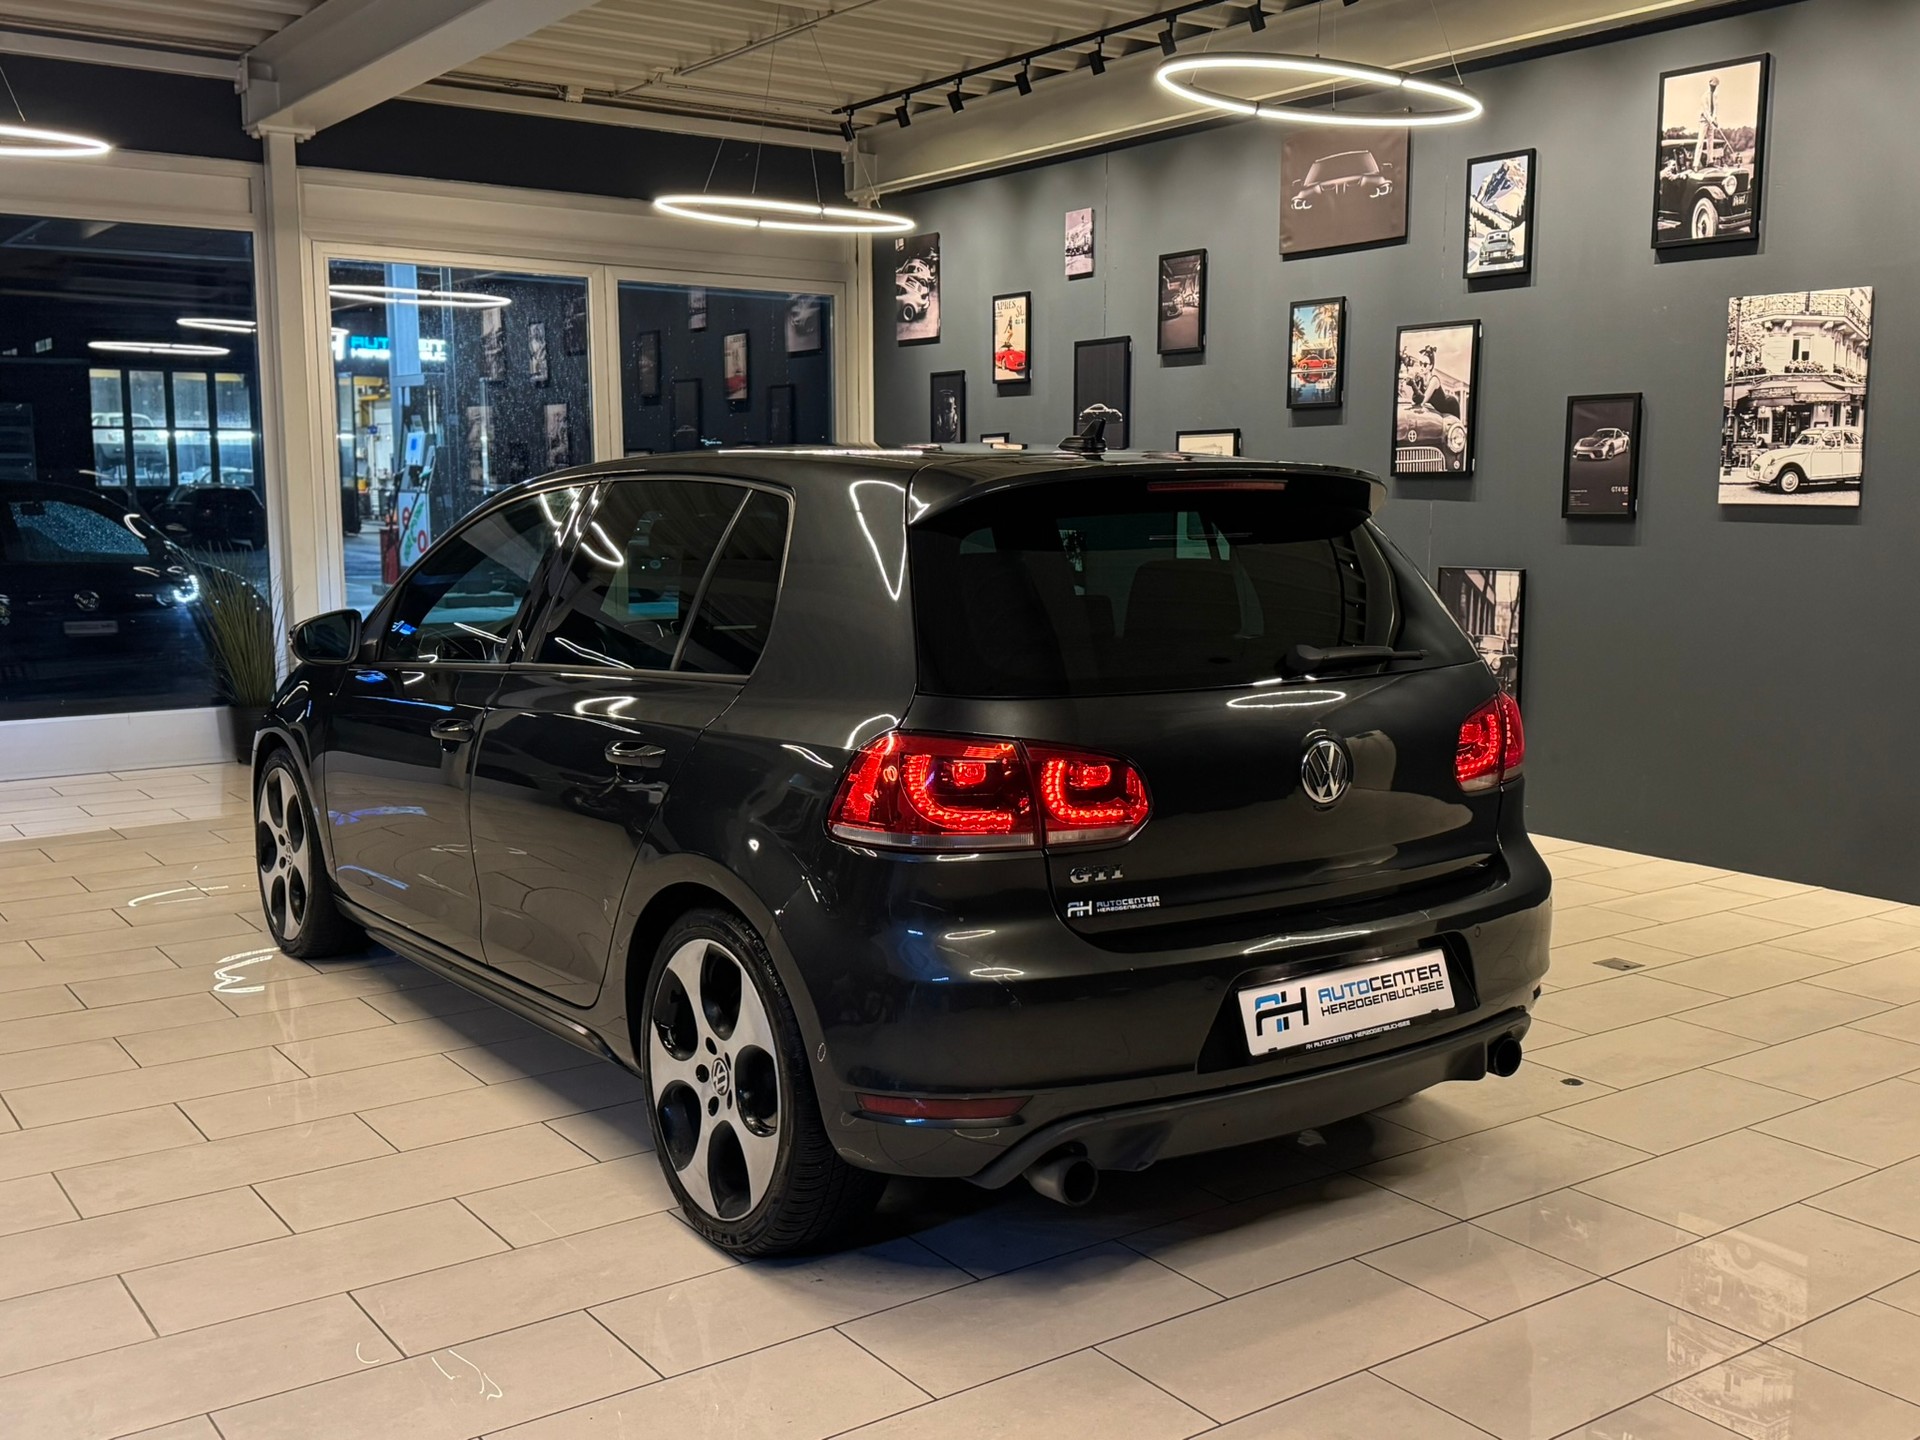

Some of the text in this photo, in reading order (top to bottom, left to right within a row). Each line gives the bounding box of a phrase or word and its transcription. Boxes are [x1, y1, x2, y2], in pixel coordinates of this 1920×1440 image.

[1069, 864, 1124, 884] GTI
[1096, 895, 1160, 908] AUTOCENTER
[1097, 901, 1160, 913] HERZOGENBUCHSEE
[1317, 963, 1442, 1004] AUTOCENTER
[1320, 980, 1445, 1017] HERZOGENBUCHSEE
[1313, 1033, 1353, 1049] AUTOCENTER
[1354, 1020, 1411, 1039] HERZOGENBUCHSEE
